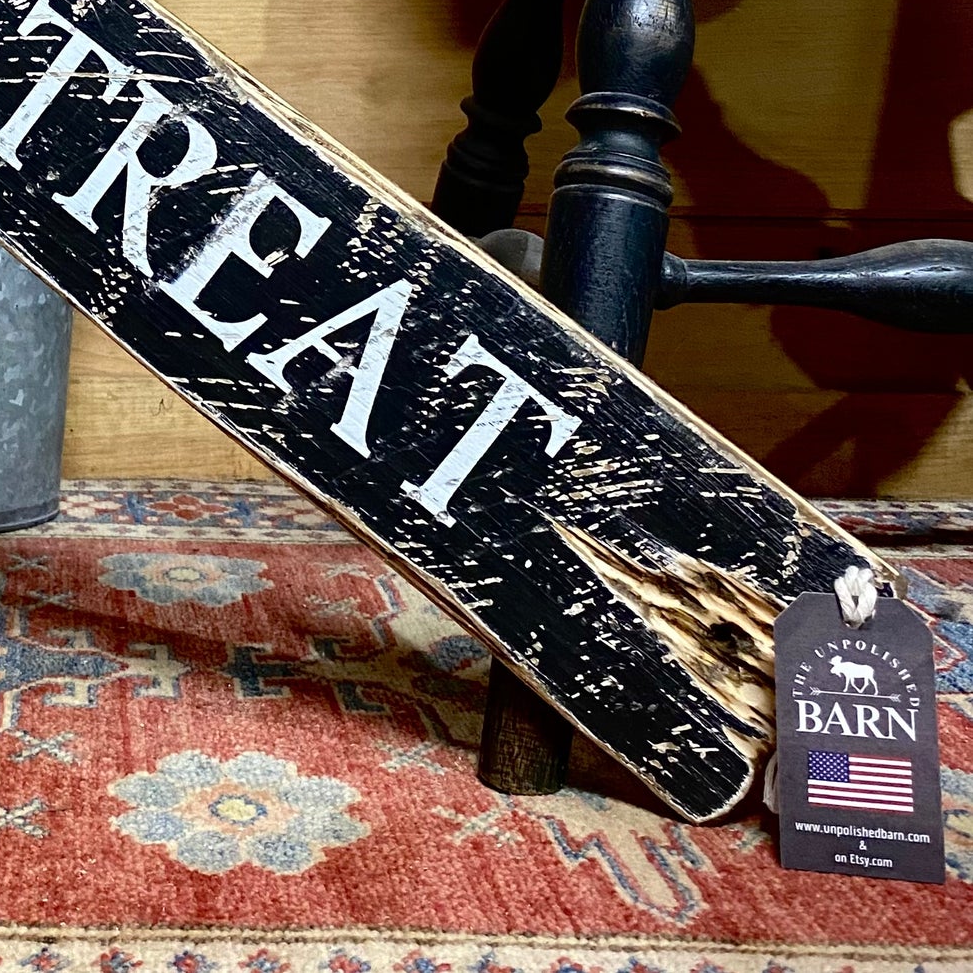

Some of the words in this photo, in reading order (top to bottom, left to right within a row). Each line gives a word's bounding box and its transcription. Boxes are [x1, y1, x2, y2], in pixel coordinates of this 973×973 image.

[792, 661, 812, 698] THE
[814, 639, 920, 707] UNPOLISHED
[794, 699, 919, 742] BARN
[795, 821, 931, 844] www.unpolishedbarn.com
[858, 840, 868, 851] &
[834, 853, 847, 863] on
[850, 853, 893, 868] Etsy.com
